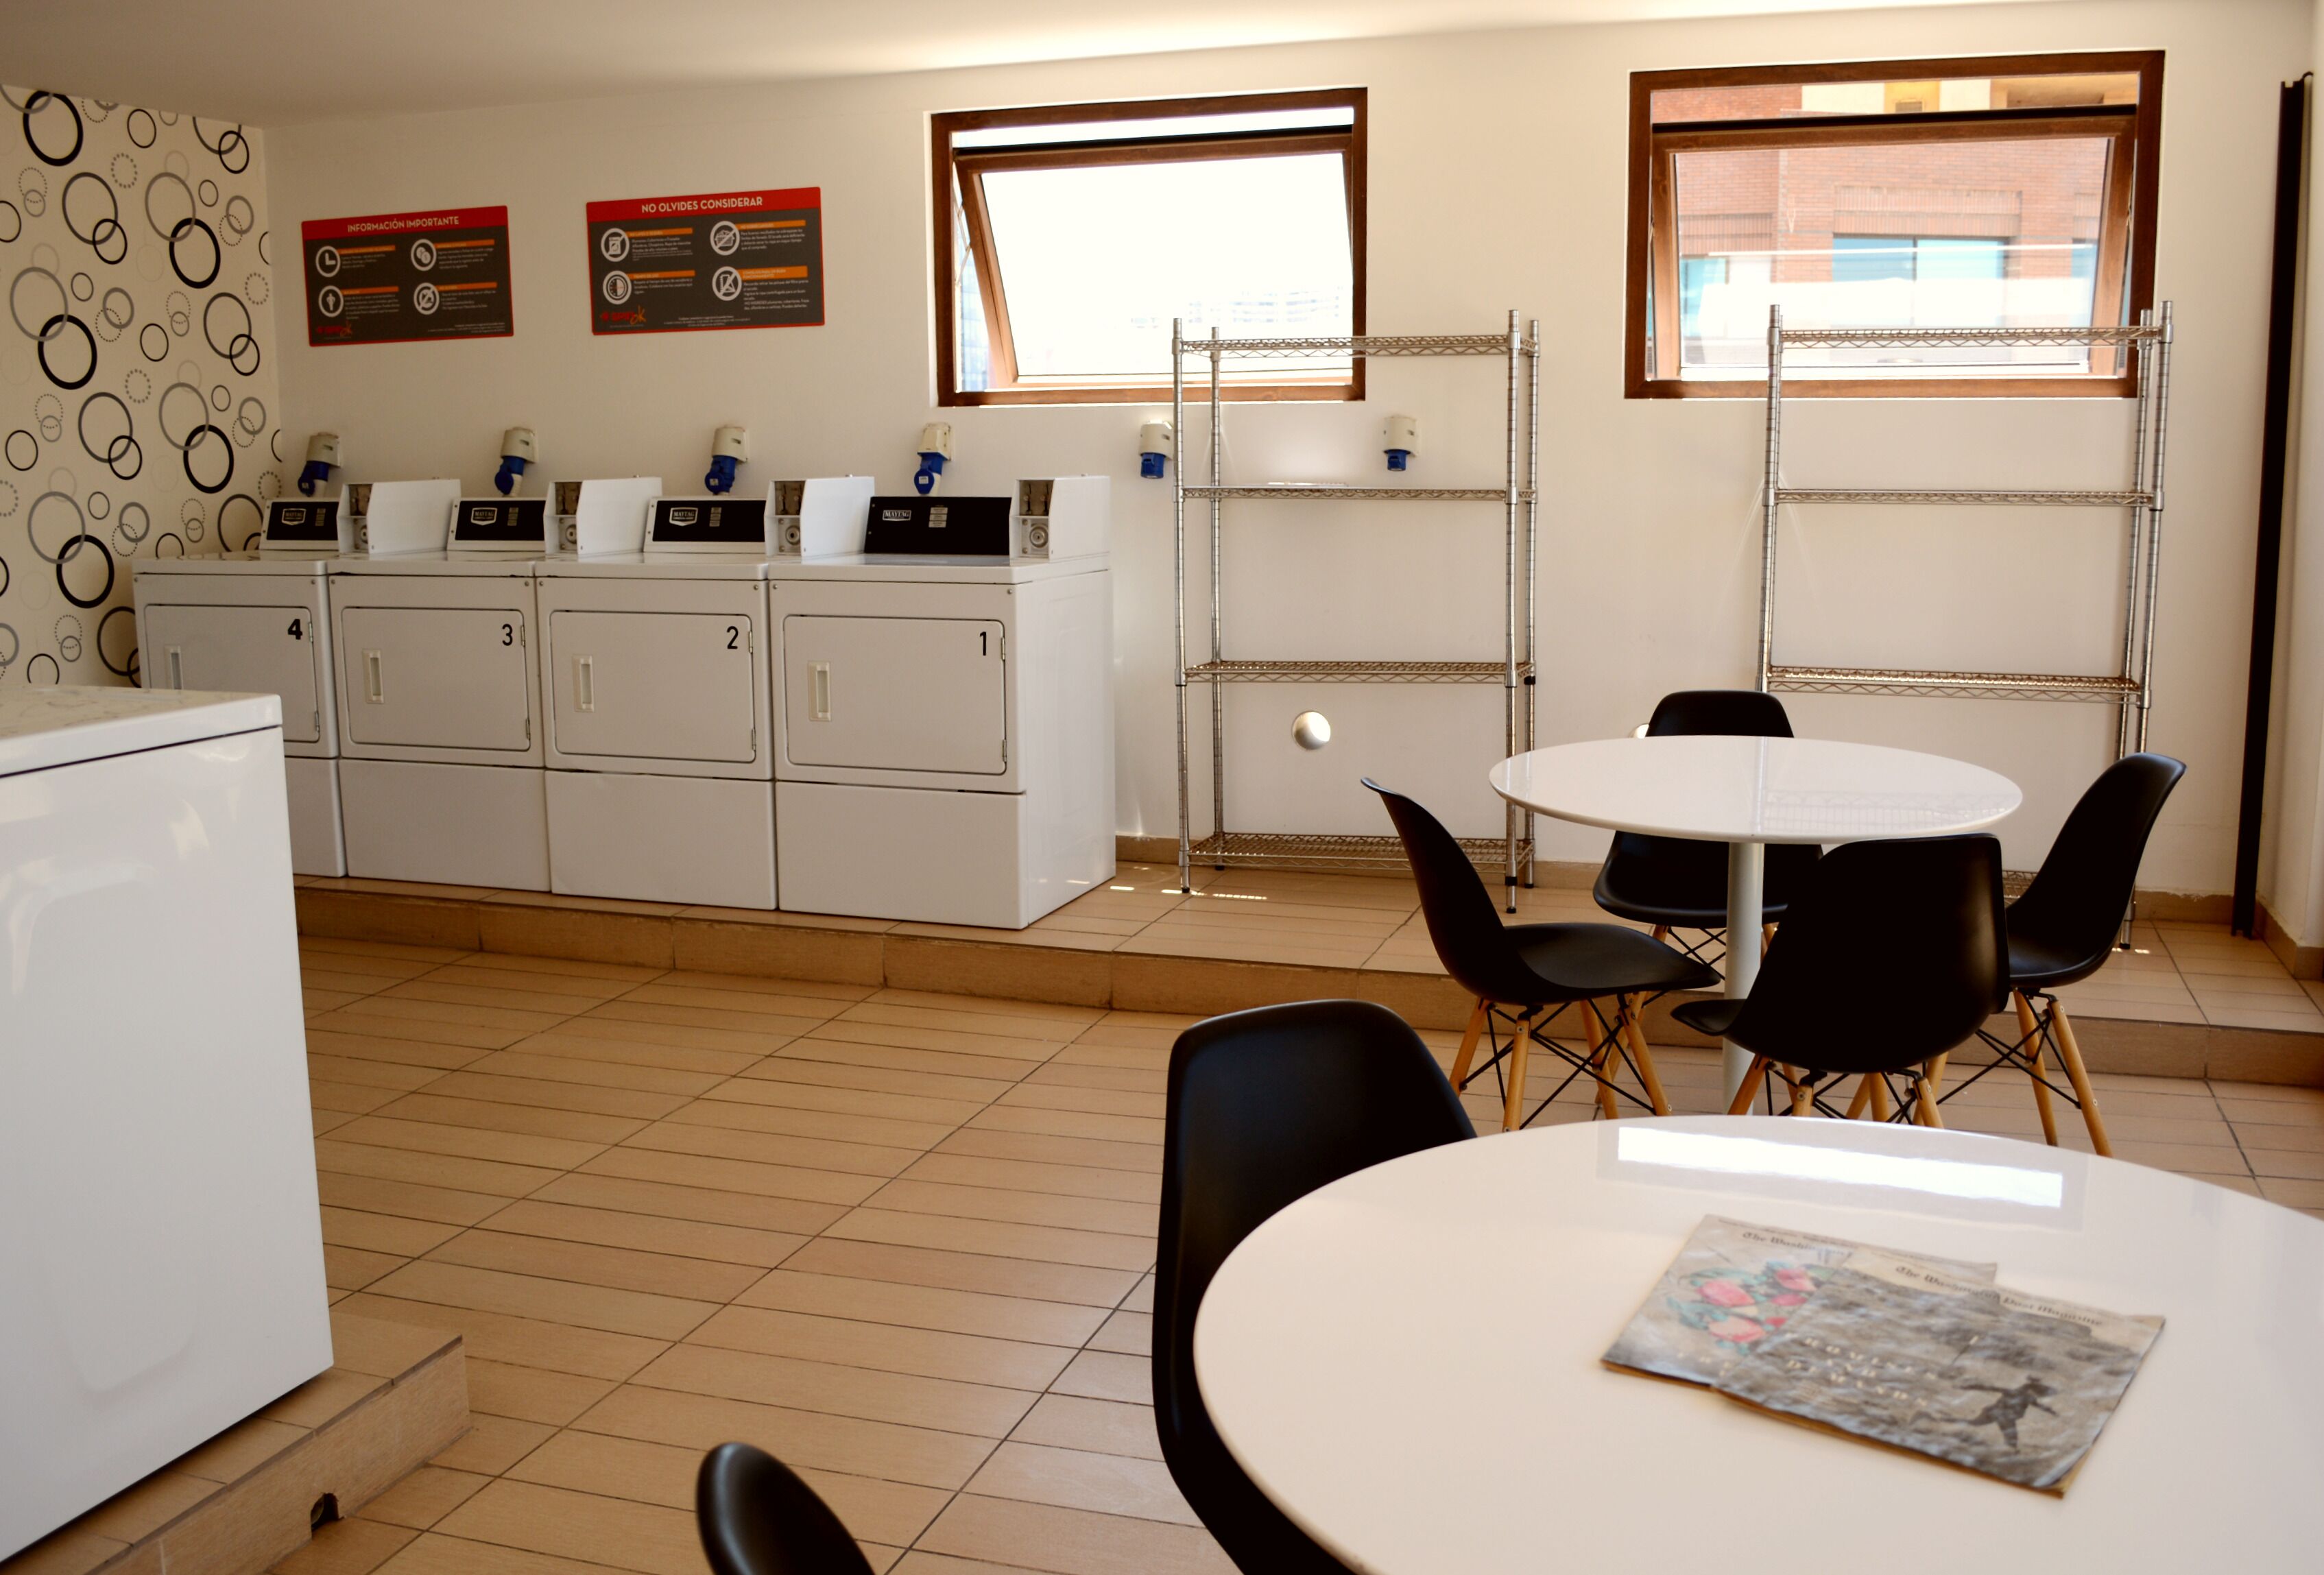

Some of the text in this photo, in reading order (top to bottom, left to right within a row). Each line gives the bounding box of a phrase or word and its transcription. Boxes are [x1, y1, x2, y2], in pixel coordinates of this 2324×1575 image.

[642, 197, 763, 213] NO OLVIDES CONSIDERAR
[348, 216, 459, 232] INFORMACIÓN IMPORTANTE
[287, 618, 303, 640] 4
[502, 623, 513, 646] 3
[726, 625, 739, 649] 2
[979, 632, 987, 656] 1
[1895, 1265, 1921, 1279] The
